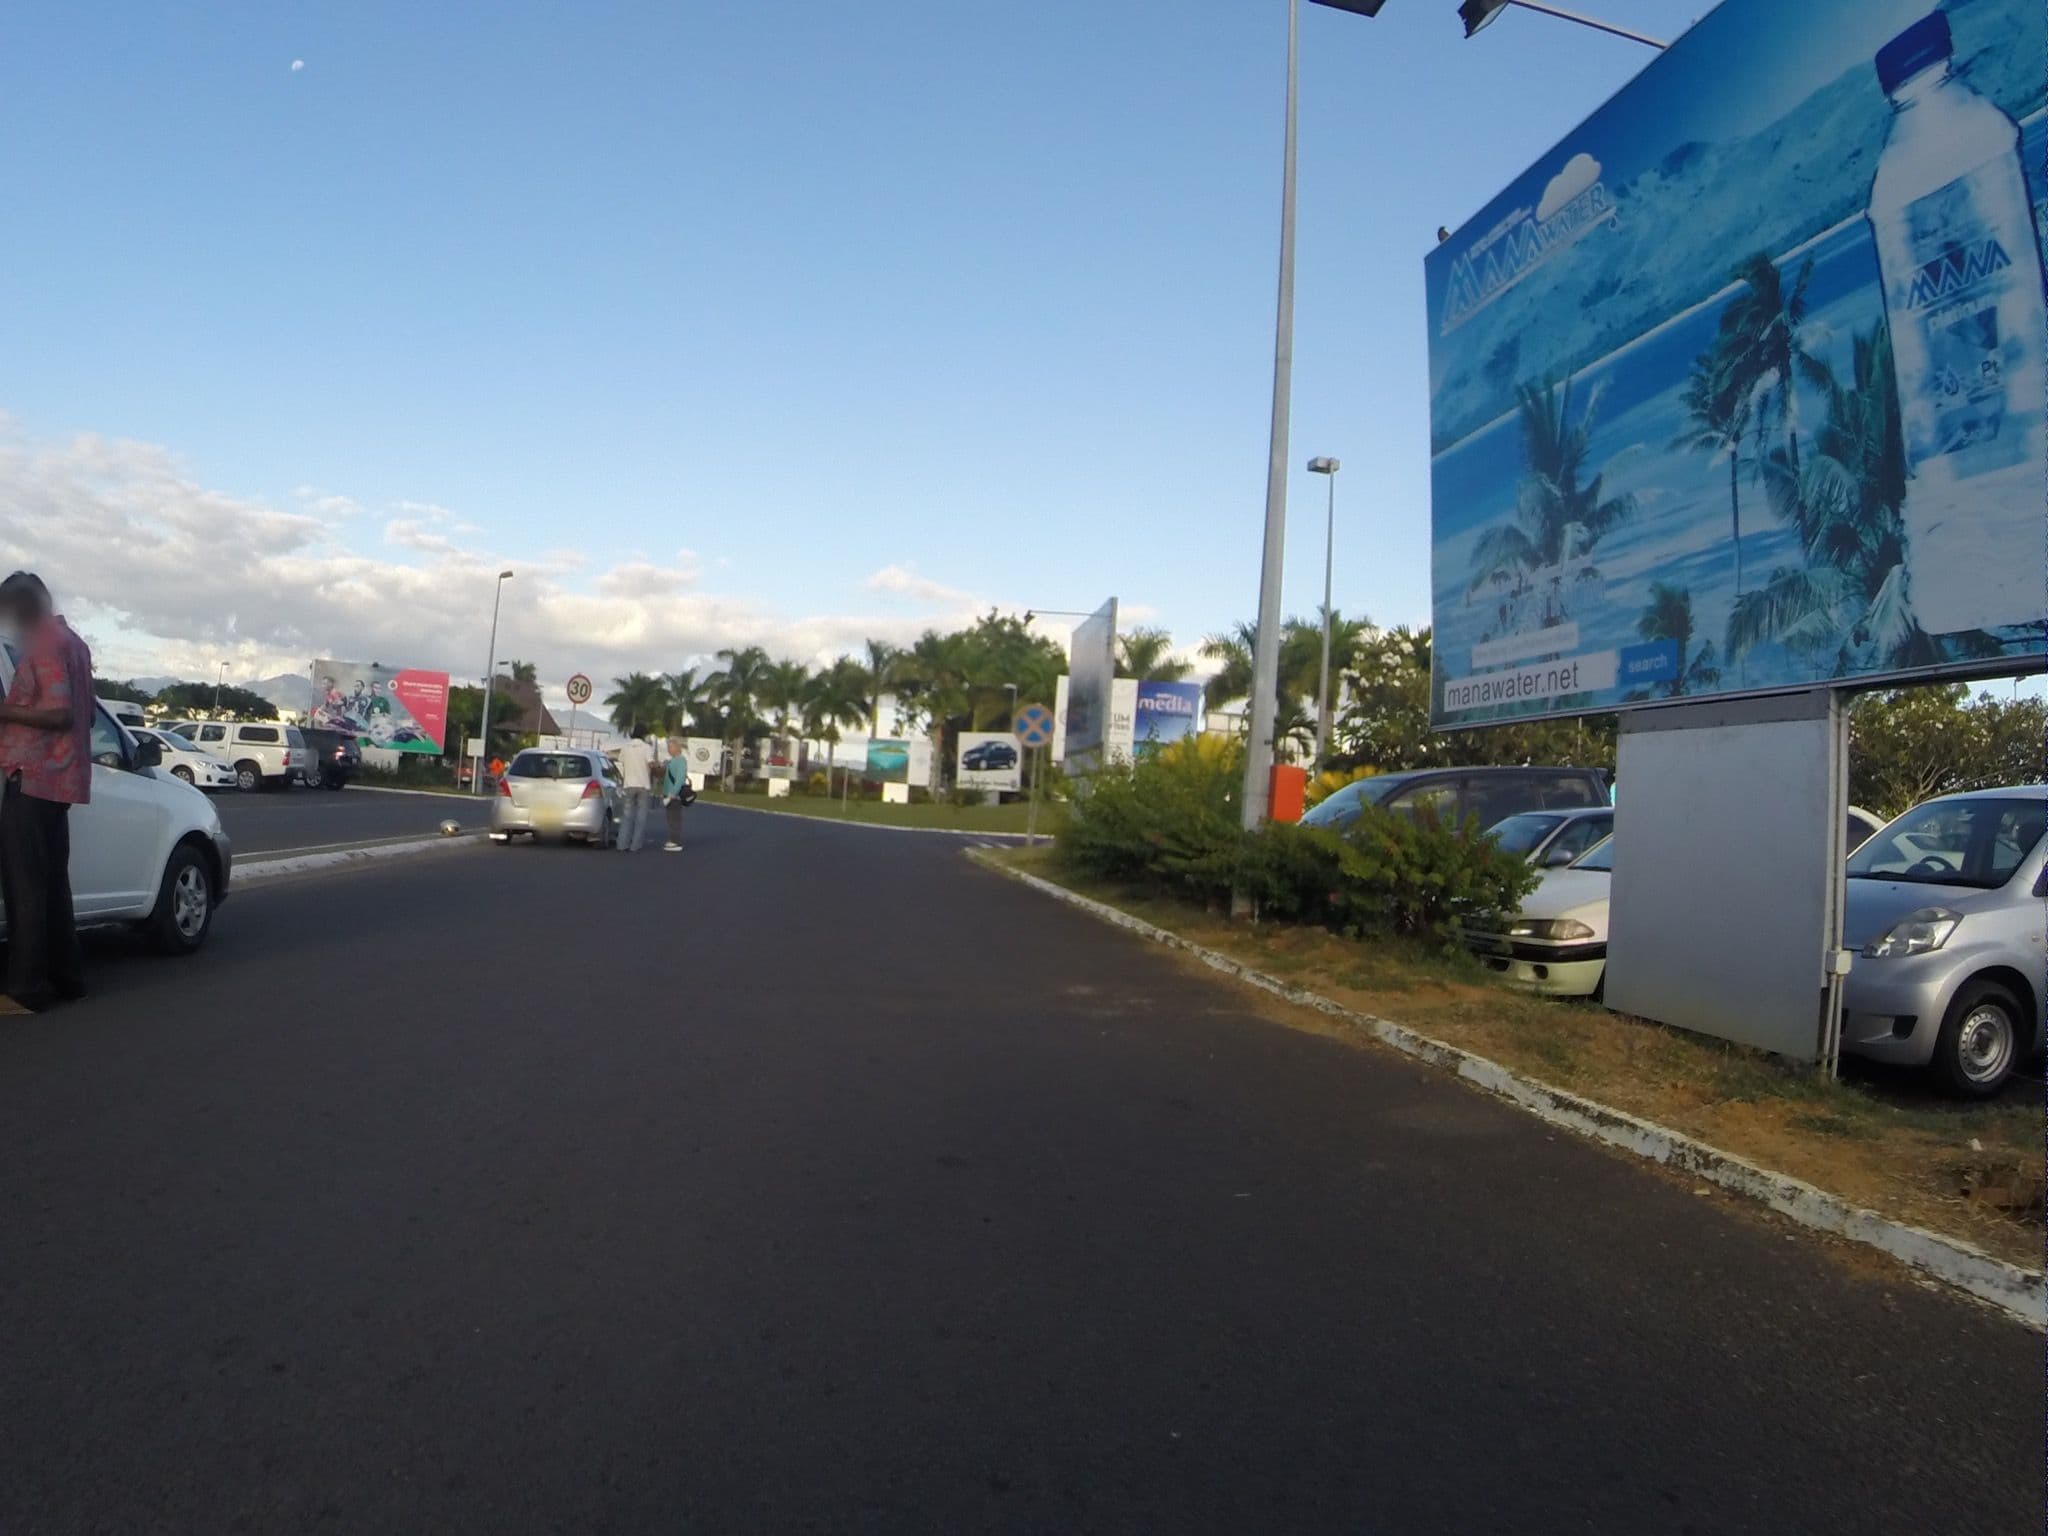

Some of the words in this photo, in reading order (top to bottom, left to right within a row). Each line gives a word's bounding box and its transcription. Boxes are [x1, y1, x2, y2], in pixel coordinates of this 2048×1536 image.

[1905, 239, 2012, 311] MANA
[1628, 654, 1669, 673] search
[570, 680, 589, 698] 30
[1448, 660, 1579, 706] manawater.net
[1138, 695, 1192, 712] media
